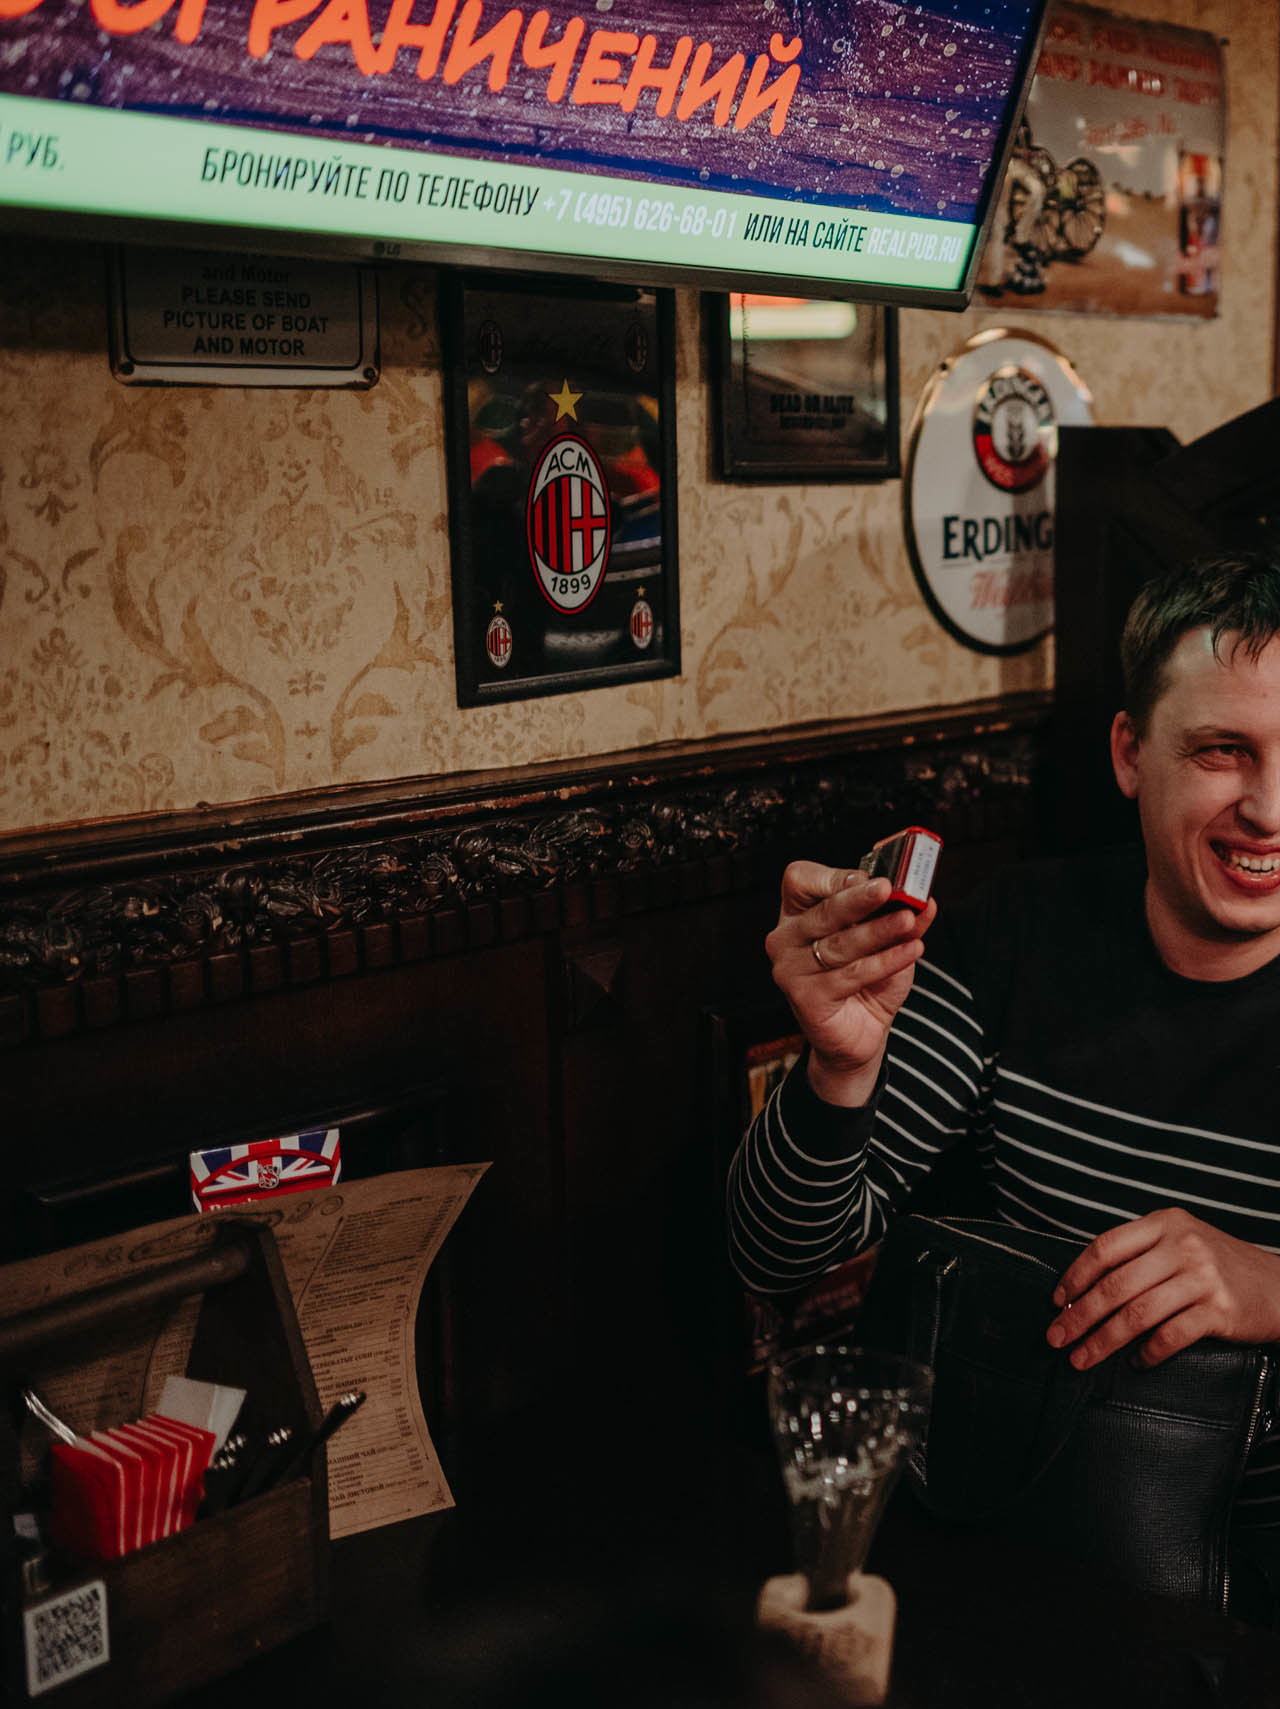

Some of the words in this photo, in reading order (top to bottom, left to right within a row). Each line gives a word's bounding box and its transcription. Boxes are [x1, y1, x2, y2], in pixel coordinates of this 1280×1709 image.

[7, 131, 65, 170] РУБ.
[201, 147, 372, 199] БРОНИРУЙТЕ
[376, 168, 410, 204] ПО
[416, 172, 540, 217] ТЕЛЕФОНУ
[543, 189, 573, 222] +7
[573, 191, 632, 229] (495)
[634, 198, 739, 240] 626-68-01
[743, 212, 784, 244] ИЛИ
[784, 217, 811, 247] НА
[812, 217, 868, 253] САЙТЕ
[867, 226, 964, 264] REALPUB.RU
[202, 264, 236, 282] and
[241, 264, 293, 283] Motor
[182, 287, 256, 307] PLEASE
[263, 290, 311, 310] SEND
[163, 310, 247, 331] PICTURE
[252, 313, 276, 332] OF
[282, 314, 329, 334] BOAT
[192, 336, 234, 355] AND
[240, 337, 306, 357] MOTOR
[544, 447, 593, 481] ACM
[551, 574, 591, 594] 1899
